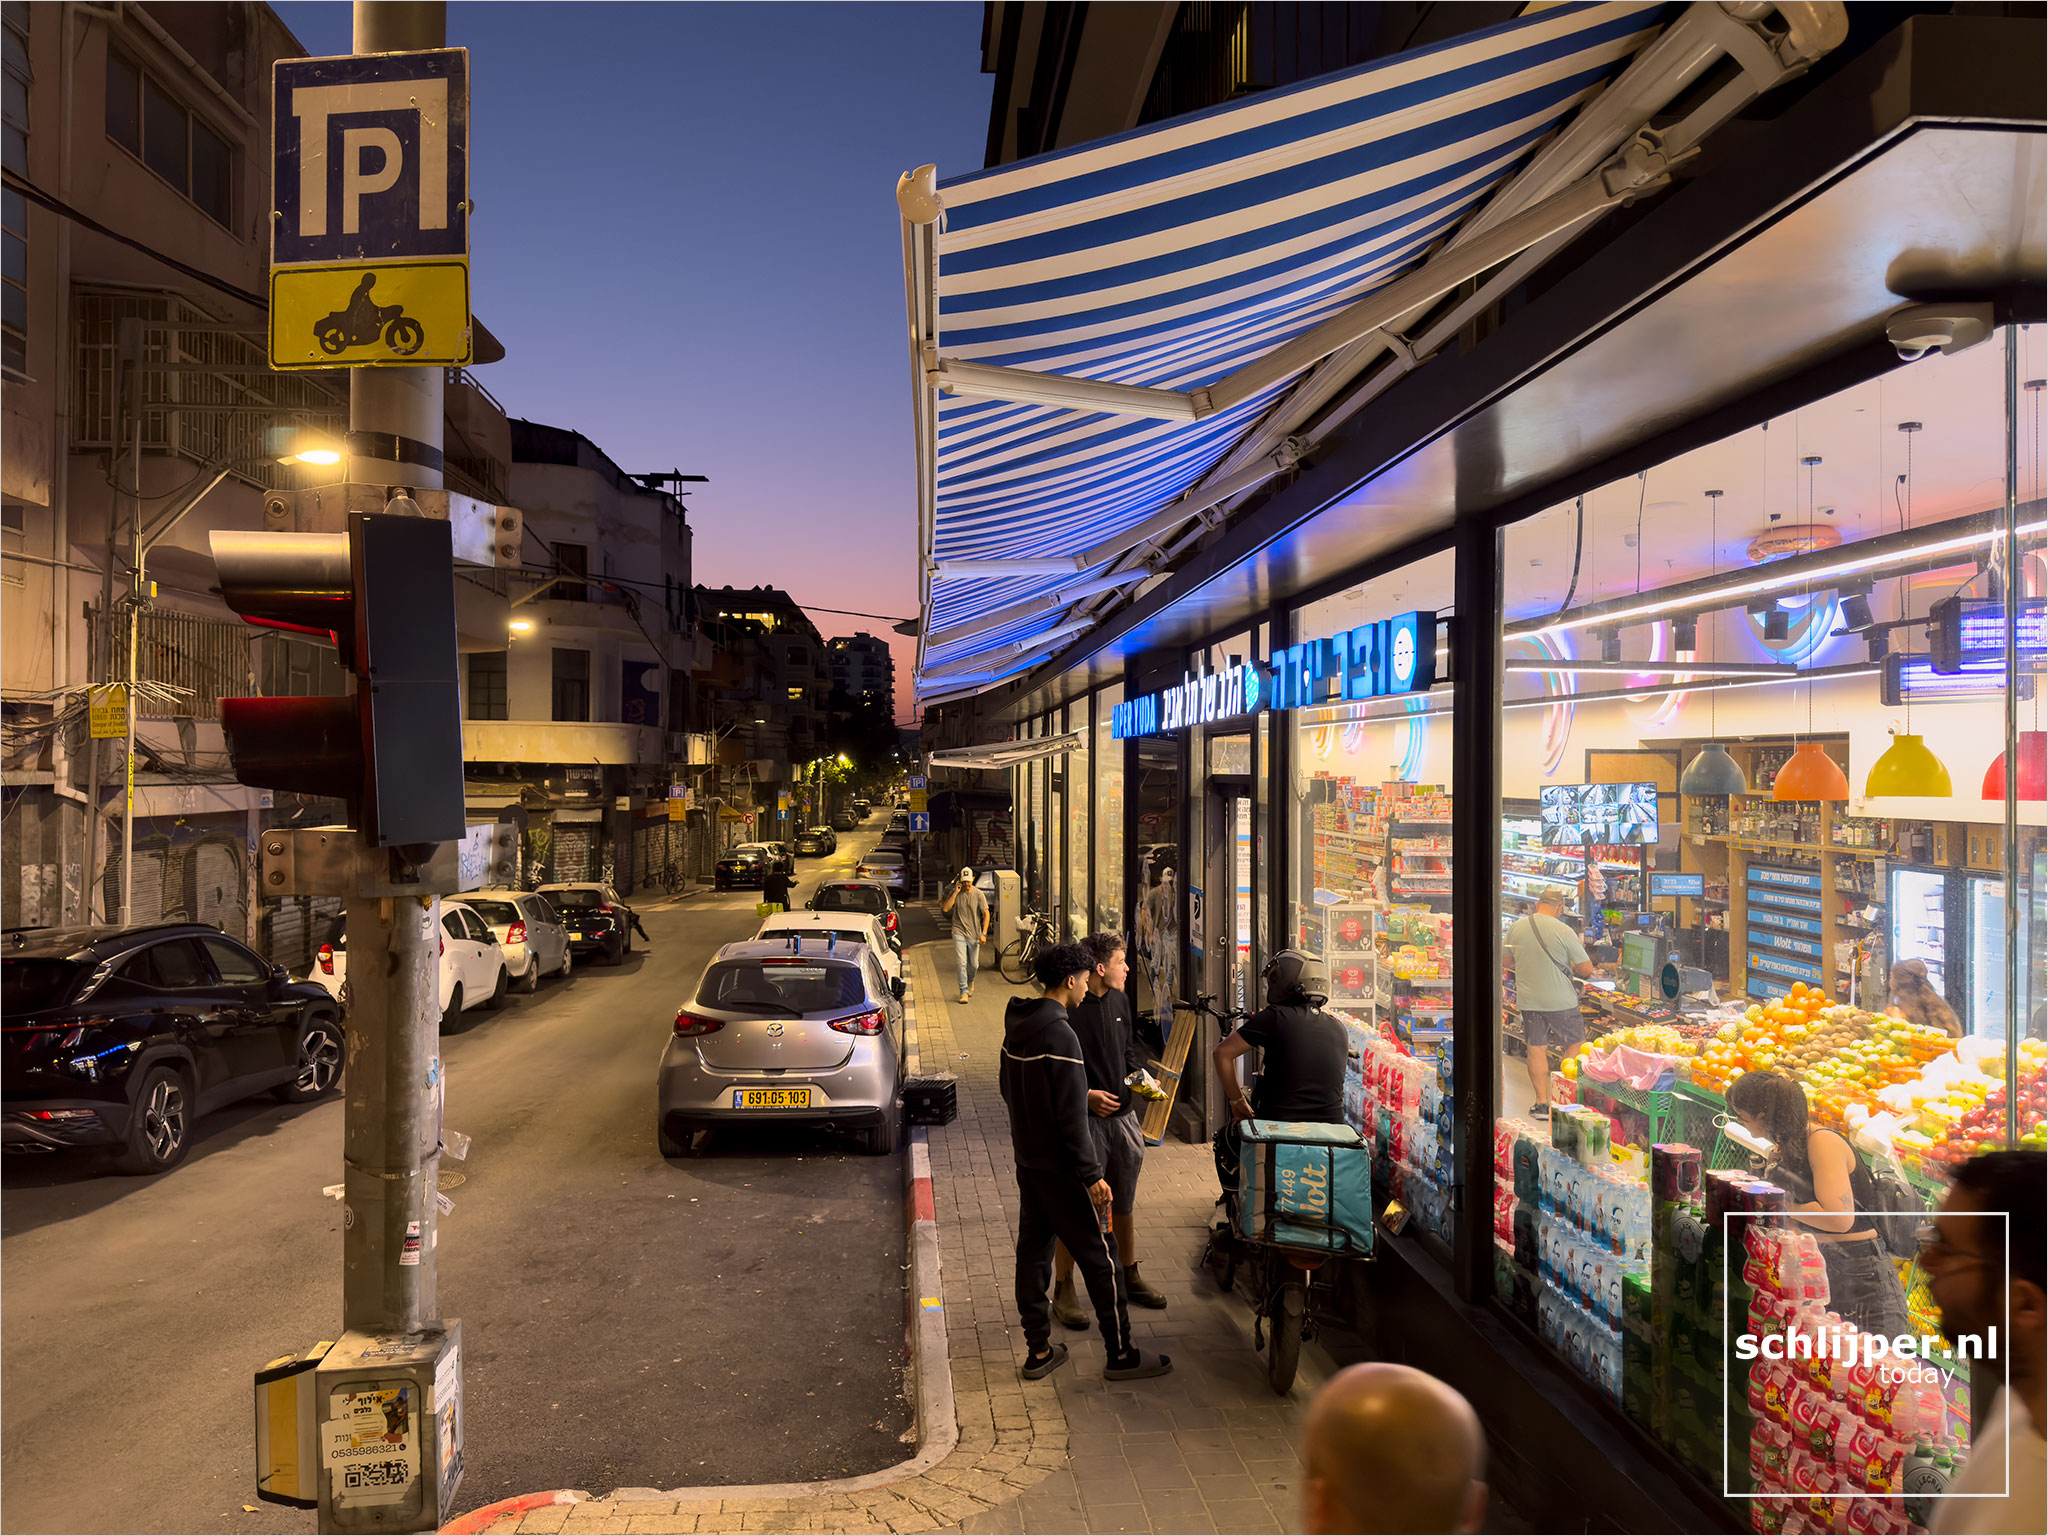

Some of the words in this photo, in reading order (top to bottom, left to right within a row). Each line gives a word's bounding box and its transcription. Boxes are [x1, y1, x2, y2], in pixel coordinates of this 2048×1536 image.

[343, 127, 404, 234] P
[1271, 638, 1323, 710] יודה
[1332, 611, 1419, 701] סופר
[1162, 685, 1183, 730] אביב
[1185, 671, 1199, 726] תל
[1200, 664, 1217, 723] של
[1217, 655, 1242, 720] הלב
[1111, 701, 1133, 739] SUPER
[1134, 693, 1157, 736] YUDA
[1774, 935, 1792, 950] Wolt
[1281, 1169, 1296, 1214] 77449
[331, 1443, 397, 1459] 0535986321
